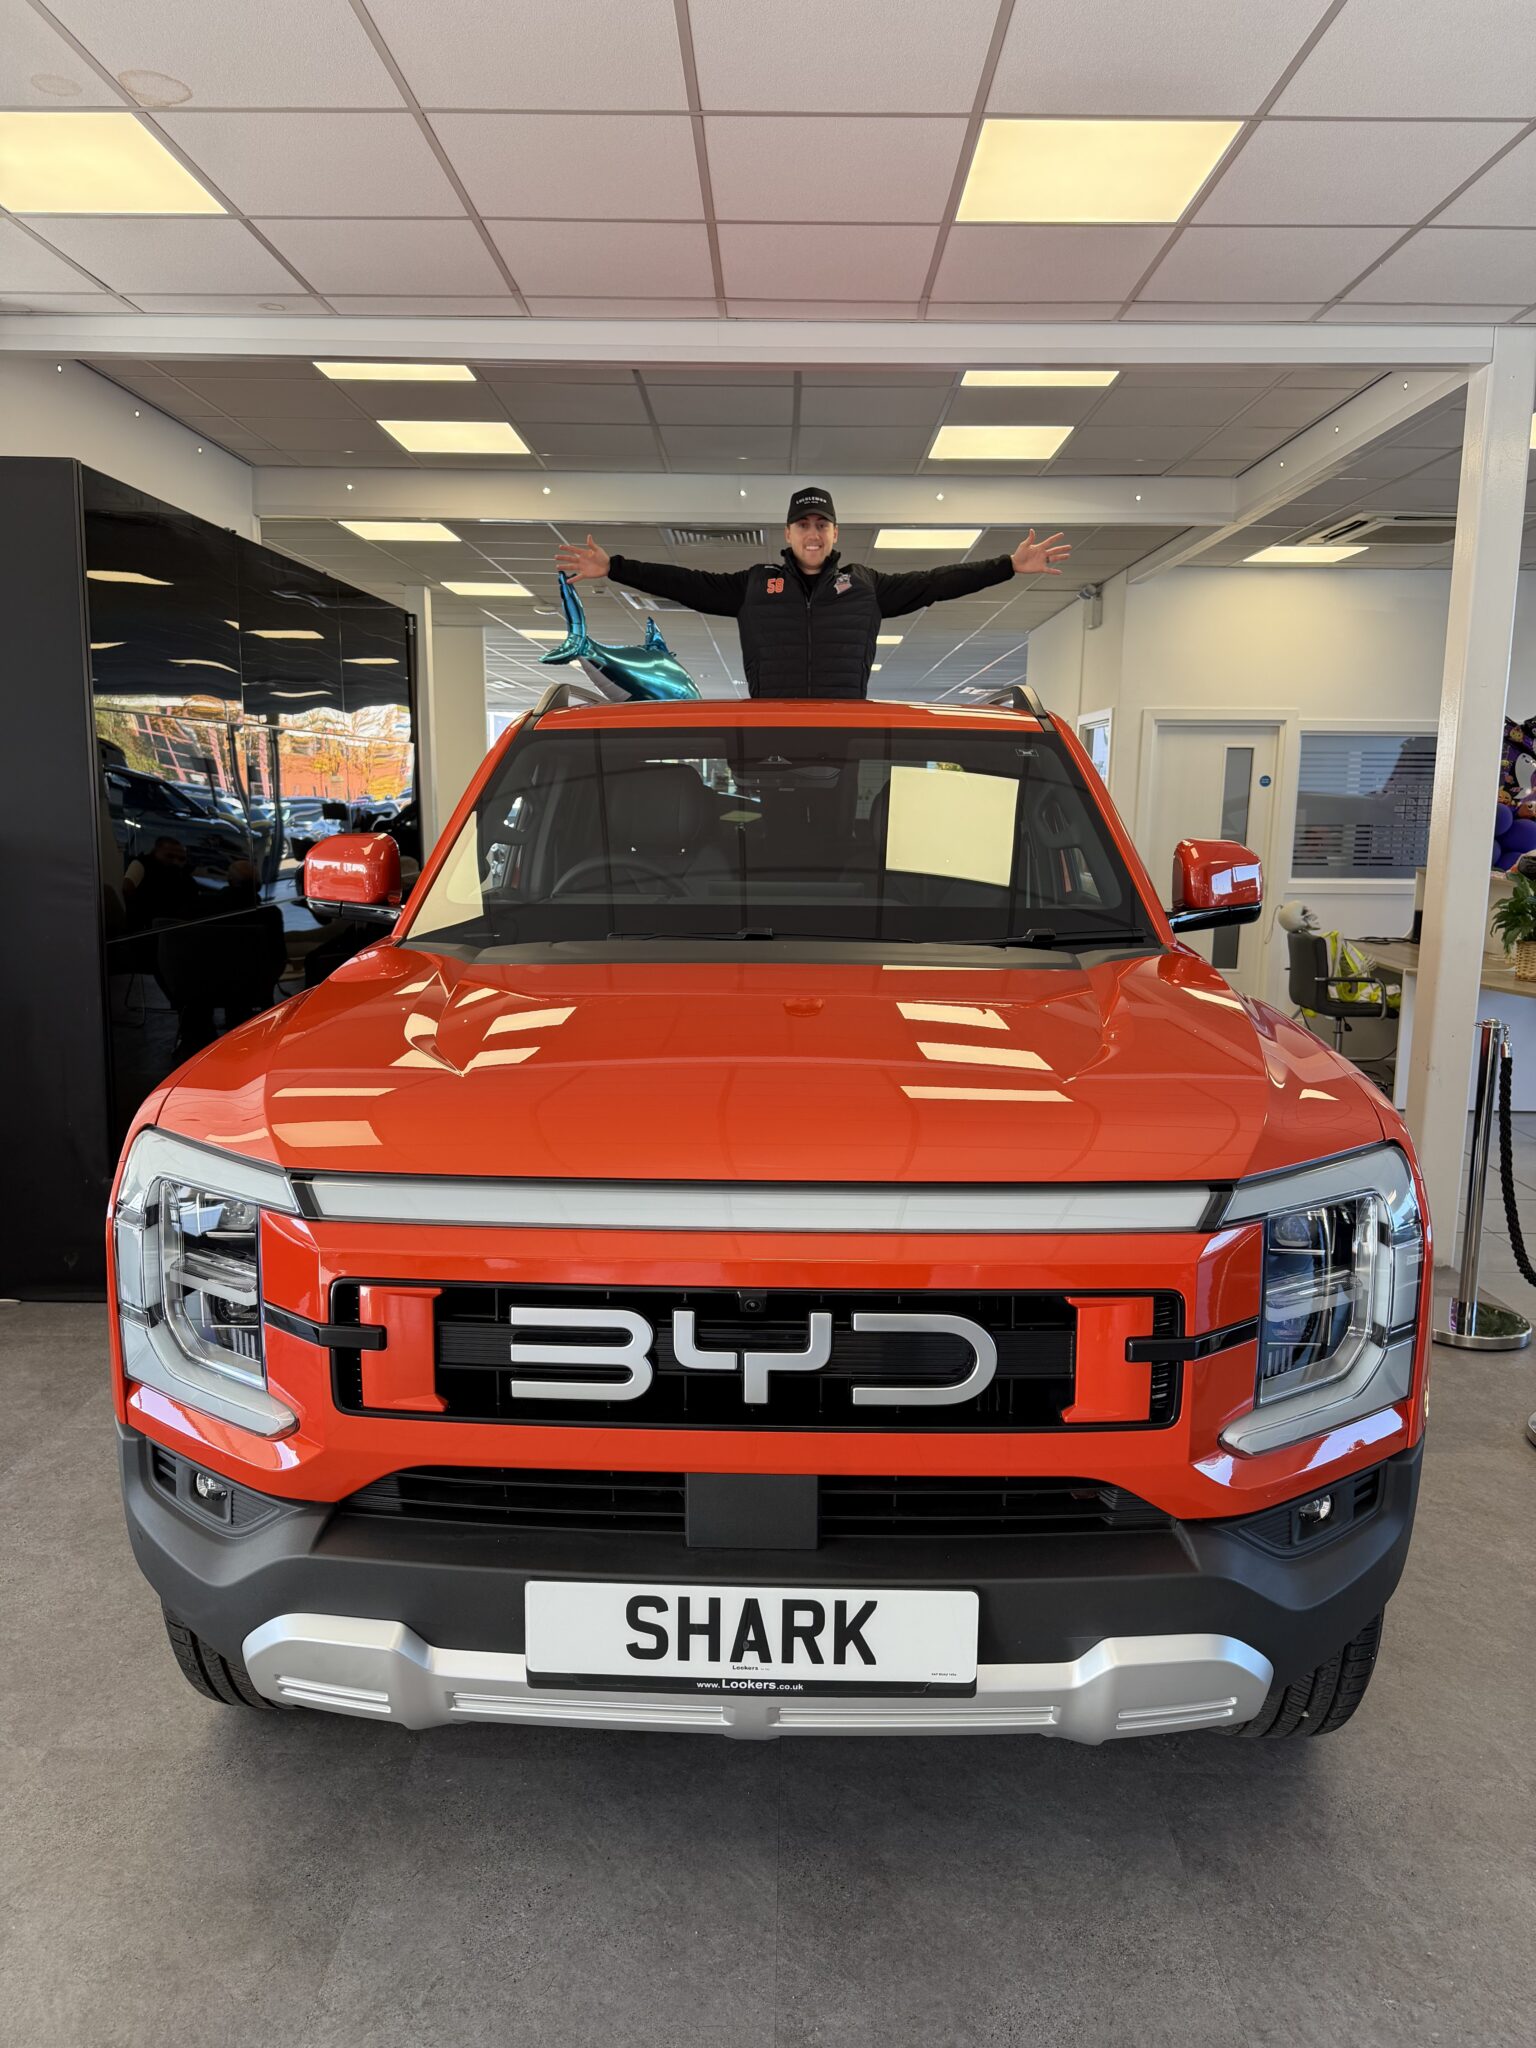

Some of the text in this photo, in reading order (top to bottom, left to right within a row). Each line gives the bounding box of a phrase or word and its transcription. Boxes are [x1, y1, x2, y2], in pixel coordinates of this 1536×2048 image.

[510, 1306, 998, 1406] BYD
[625, 1594, 879, 1666] SHARK
[696, 1679, 804, 1690] www.Lookers.co.uk
